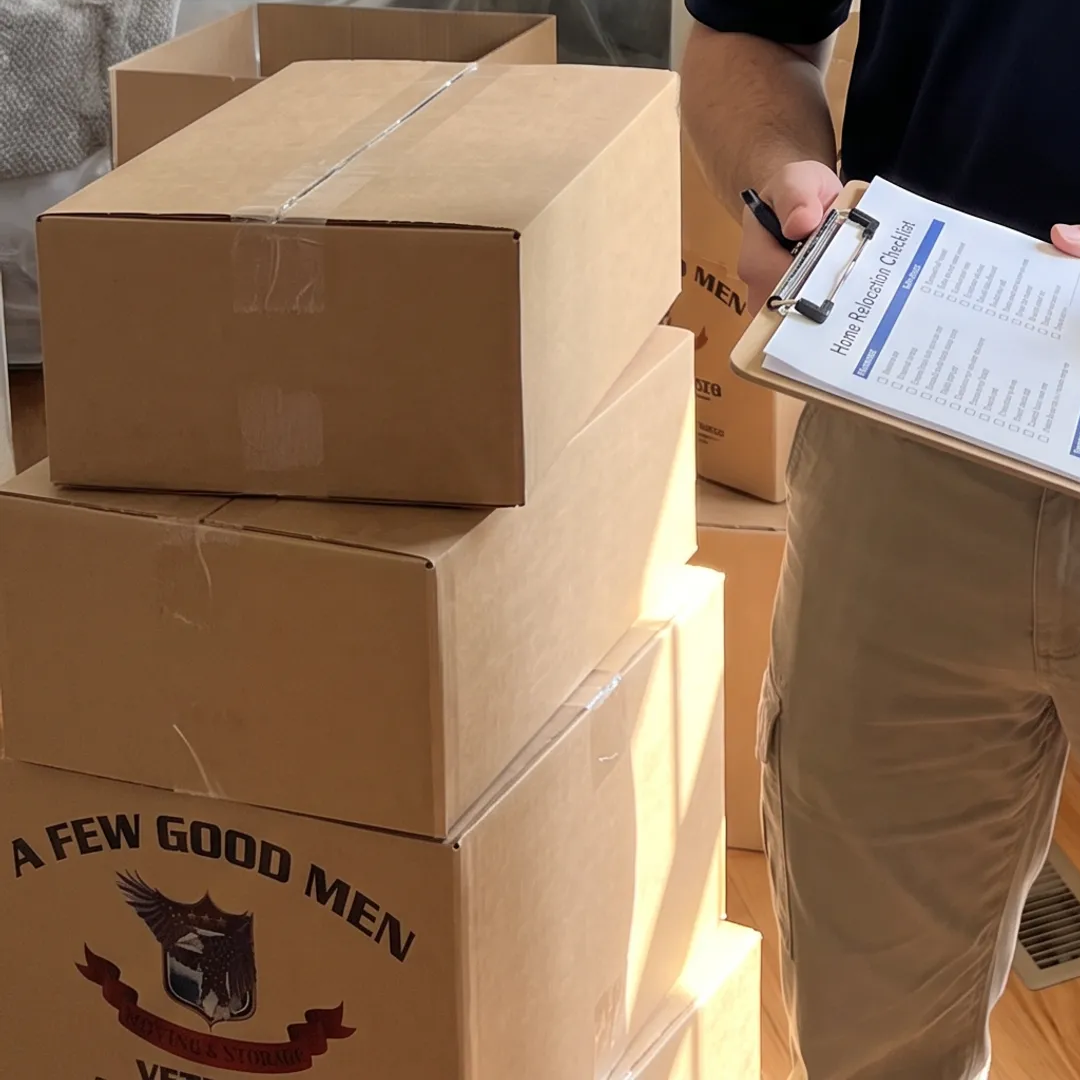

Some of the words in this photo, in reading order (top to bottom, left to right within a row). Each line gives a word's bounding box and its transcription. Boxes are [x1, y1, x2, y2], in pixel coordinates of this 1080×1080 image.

[694, 264, 747, 317] MEN
[829, 320, 861, 357] Home
[849, 266, 892, 325] Relocation
[879, 220, 916, 267] Checklist
[11, 837, 46, 878] A
[46, 813, 141, 861] FEW
[156, 814, 292, 884] GOOD
[303, 863, 417, 964] MEN
